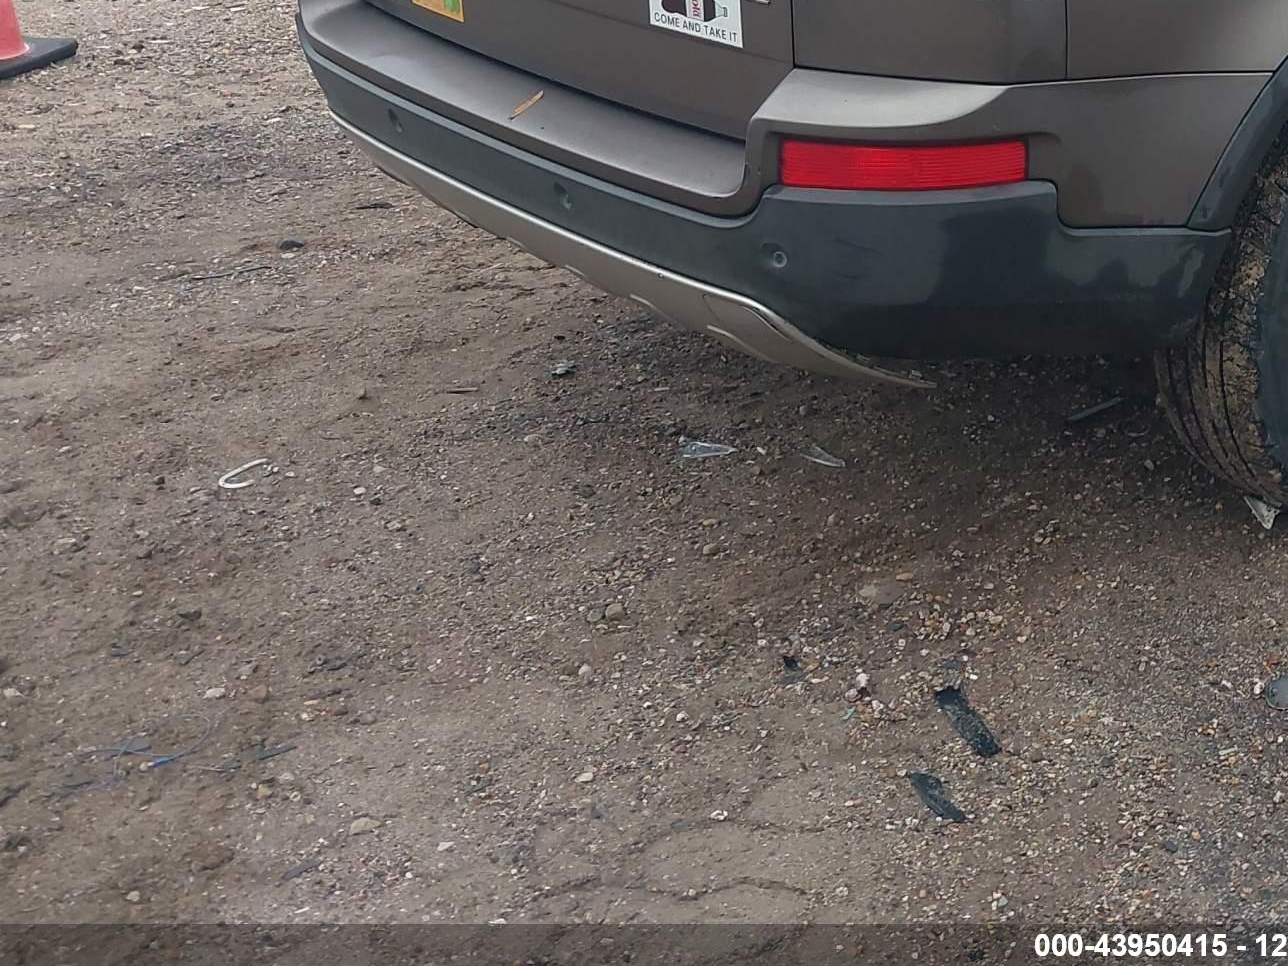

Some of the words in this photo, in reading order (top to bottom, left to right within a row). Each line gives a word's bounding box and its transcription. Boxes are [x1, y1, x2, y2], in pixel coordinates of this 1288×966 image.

[654, 12, 680, 27] COME
[682, 20, 701, 33] AND
[704, 25, 727, 40] TAKE
[729, 32, 737, 42] IT
